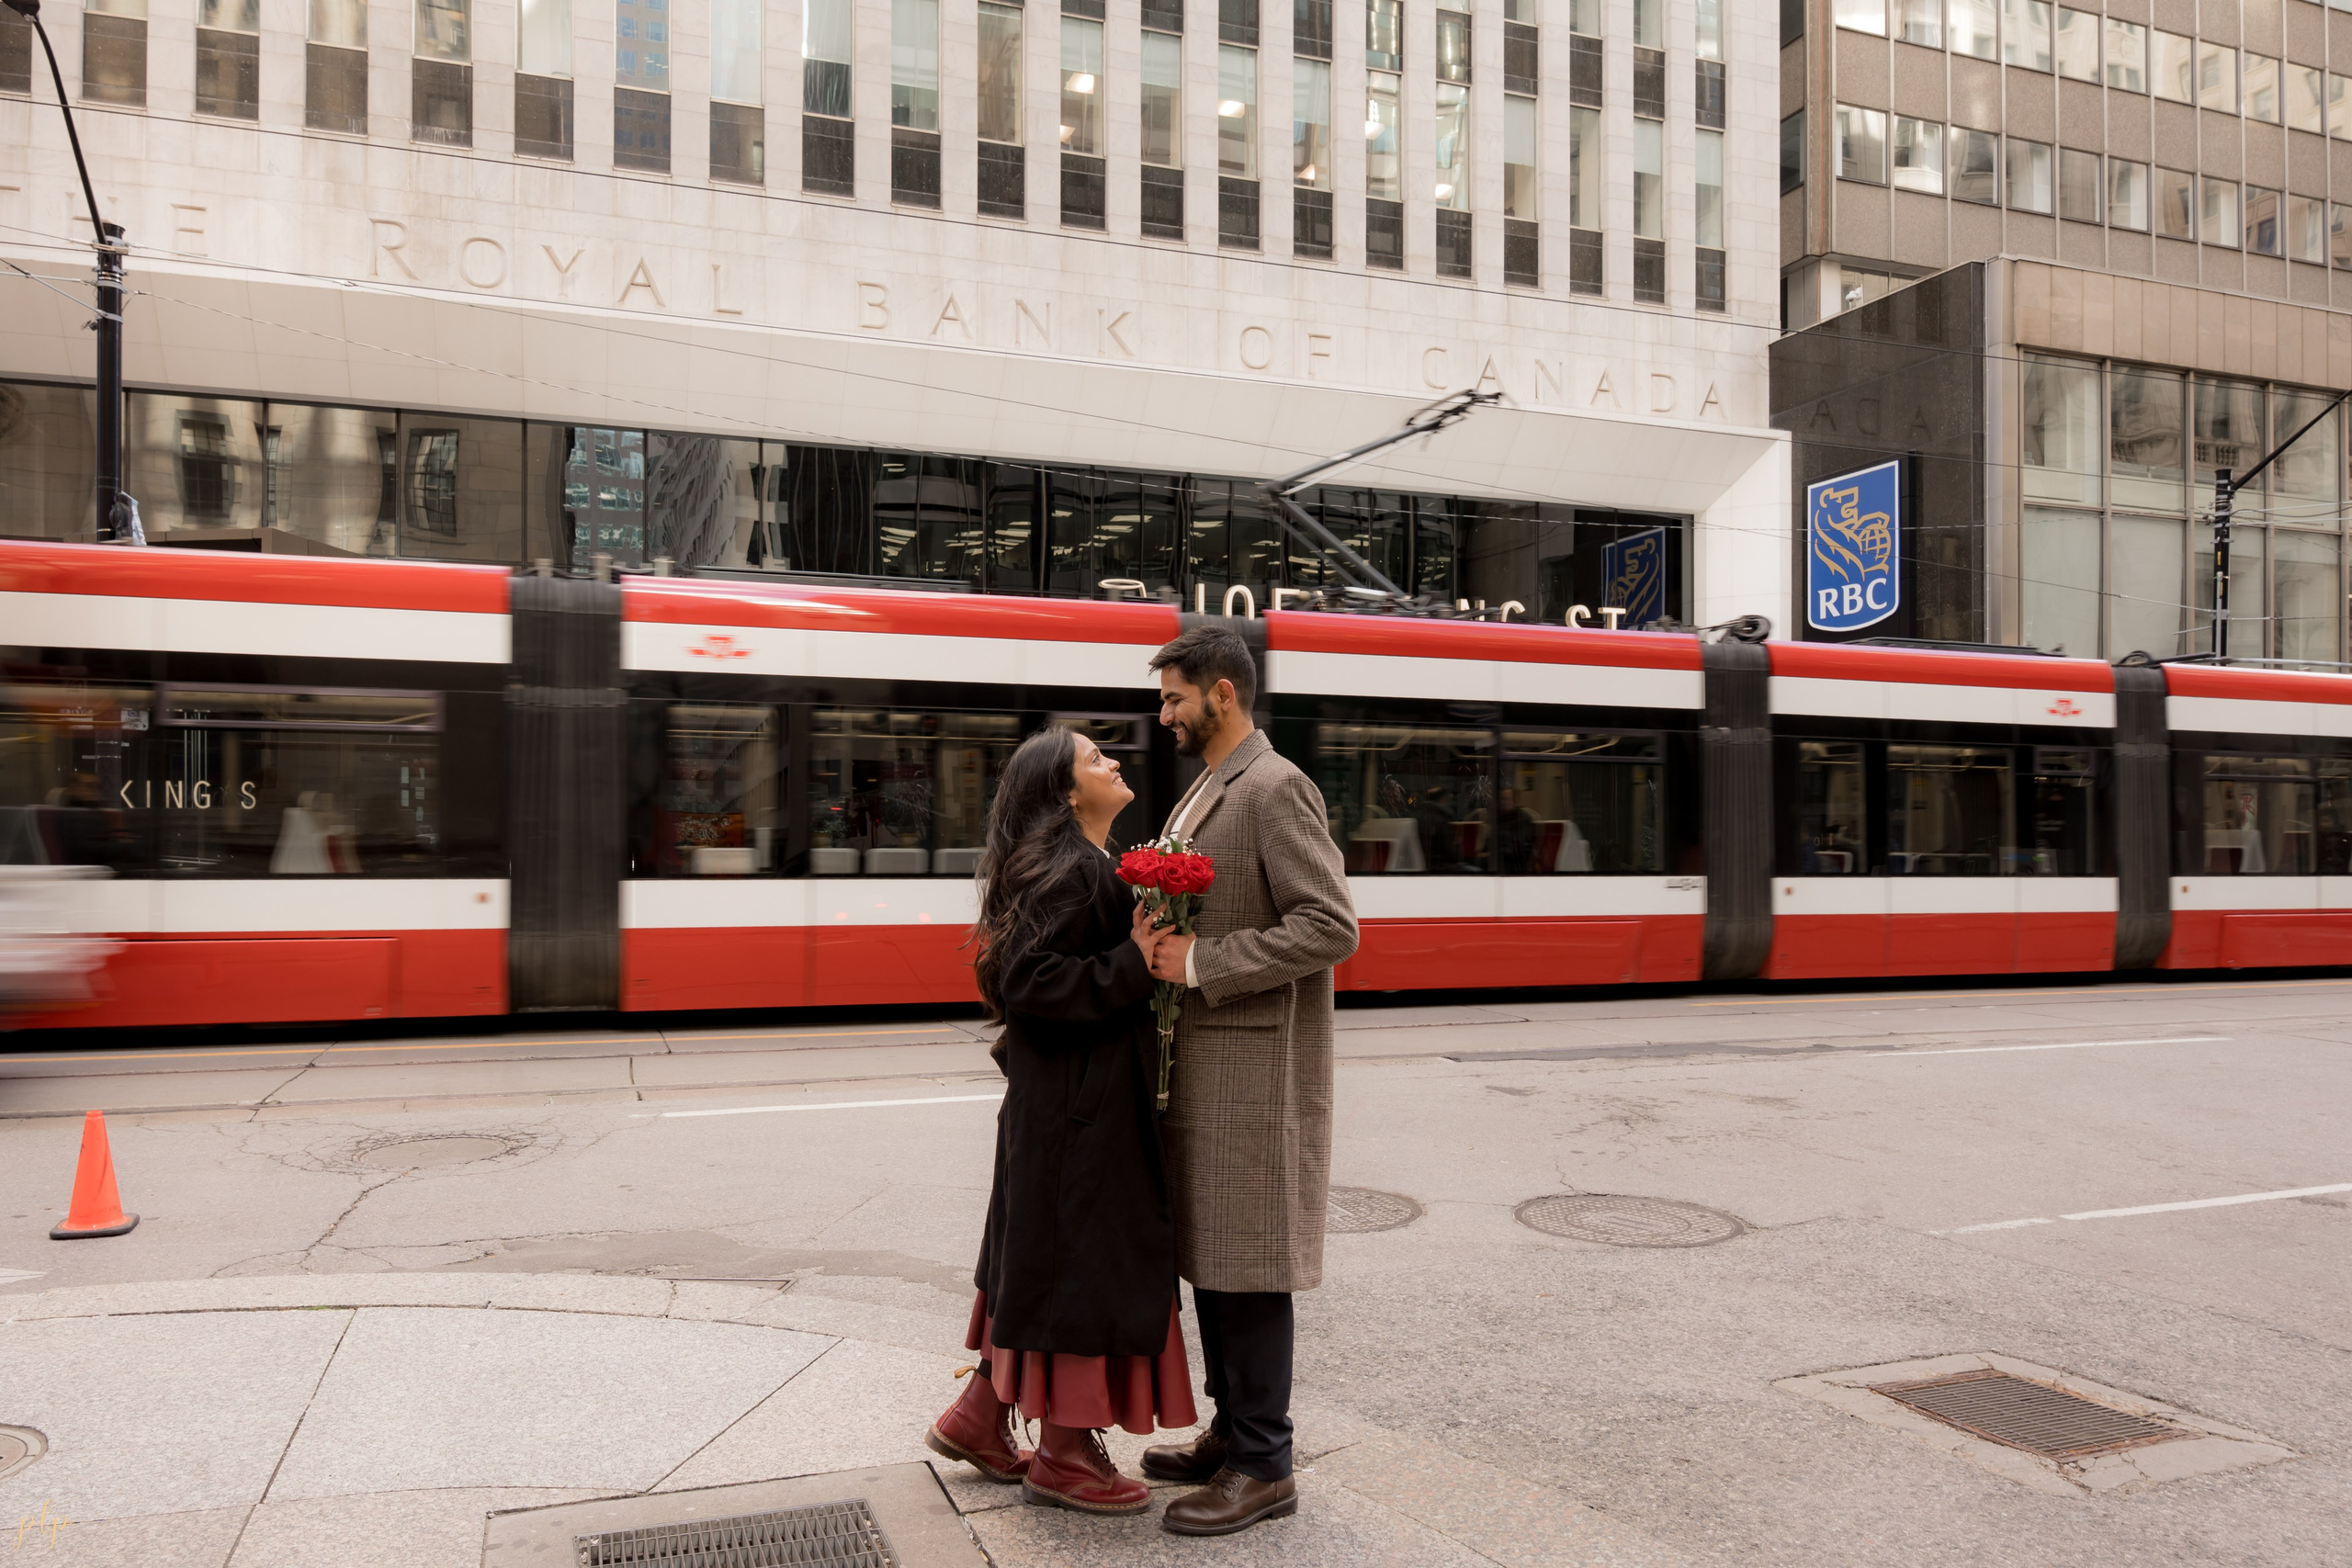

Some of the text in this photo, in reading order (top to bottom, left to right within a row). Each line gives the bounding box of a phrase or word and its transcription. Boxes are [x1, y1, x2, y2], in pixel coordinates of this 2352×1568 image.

[367, 217, 743, 316] ROYAL
[855, 279, 1138, 358] BANK
[1238, 324, 1333, 377] OF
[1420, 345, 1729, 420] CANADA
[1816, 577, 1889, 620] RBC
[119, 780, 211, 809] KING
